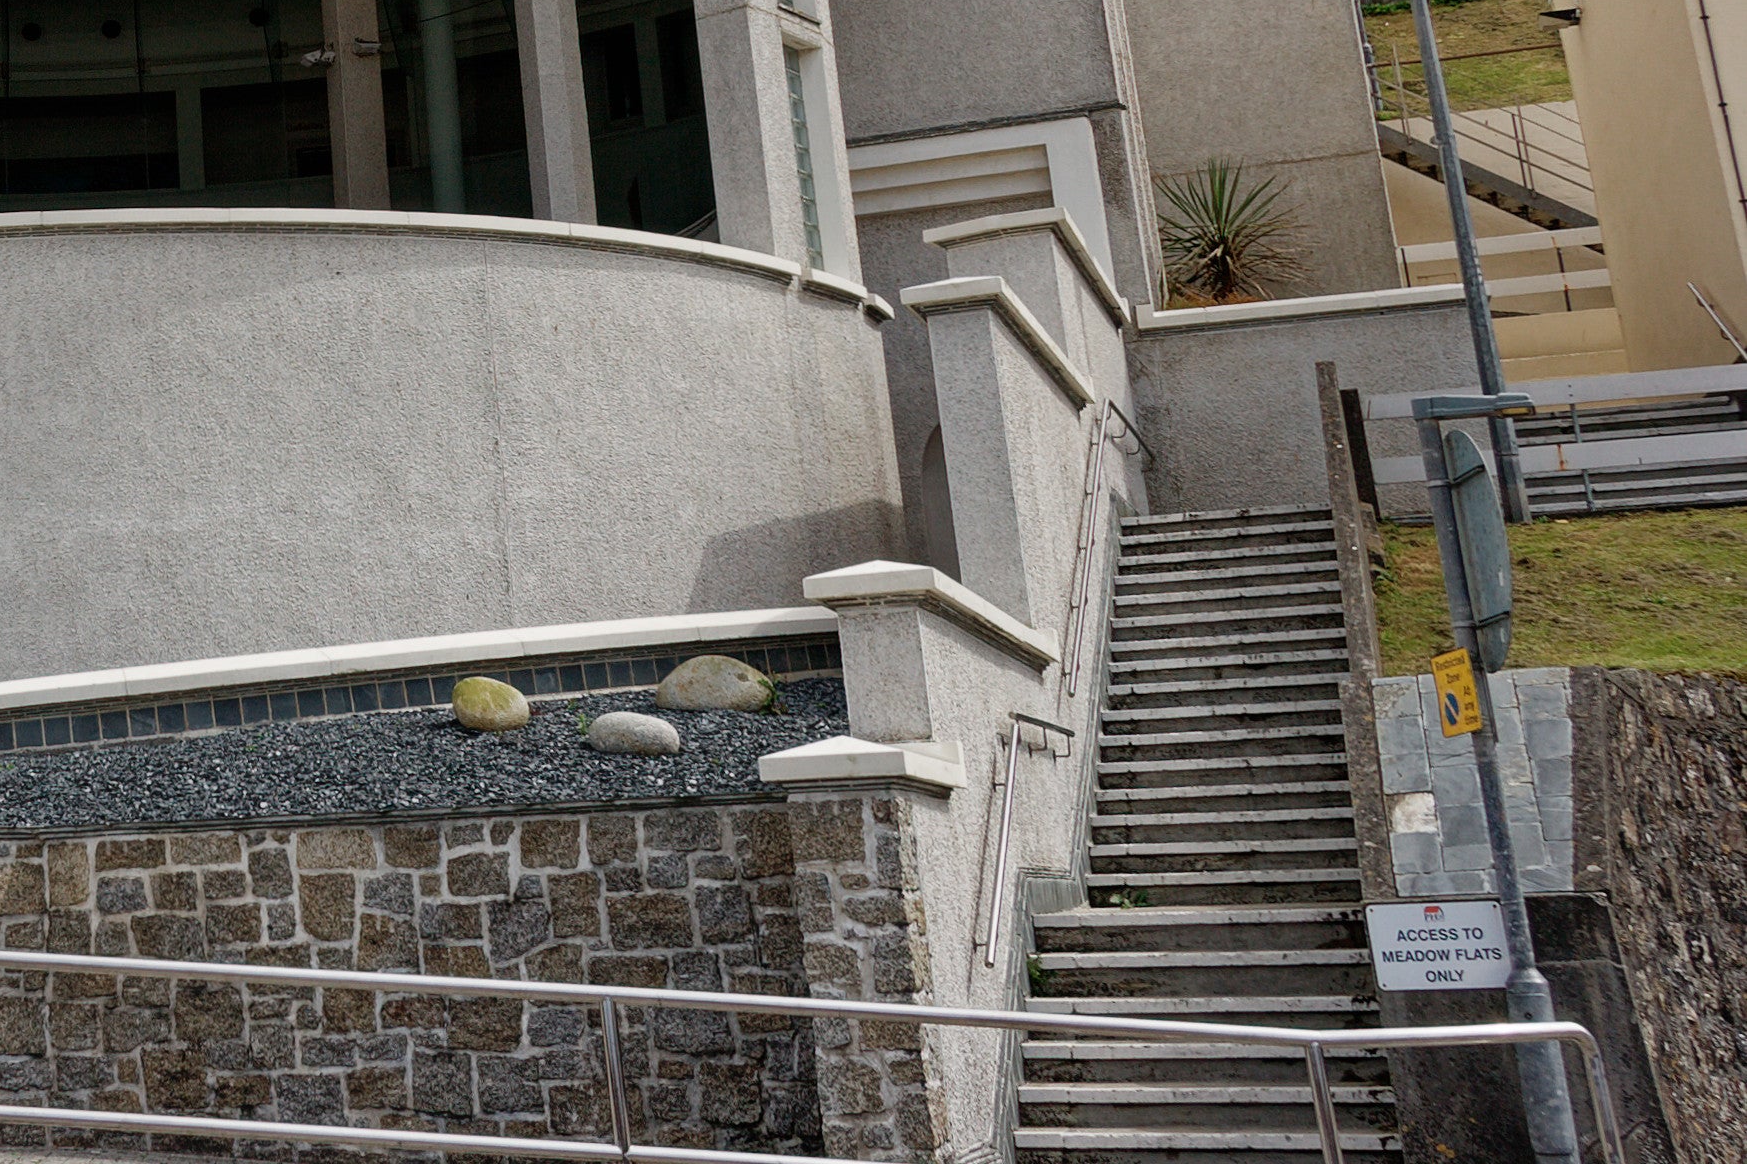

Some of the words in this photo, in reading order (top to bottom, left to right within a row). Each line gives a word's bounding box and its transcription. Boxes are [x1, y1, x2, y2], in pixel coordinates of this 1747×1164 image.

[1397, 928, 1459, 942] ACCESS
[1462, 927, 1484, 940] TO
[1382, 948, 1451, 963] MEADOW
[1455, 947, 1502, 961] FLATS
[1425, 969, 1465, 983] ONLY
